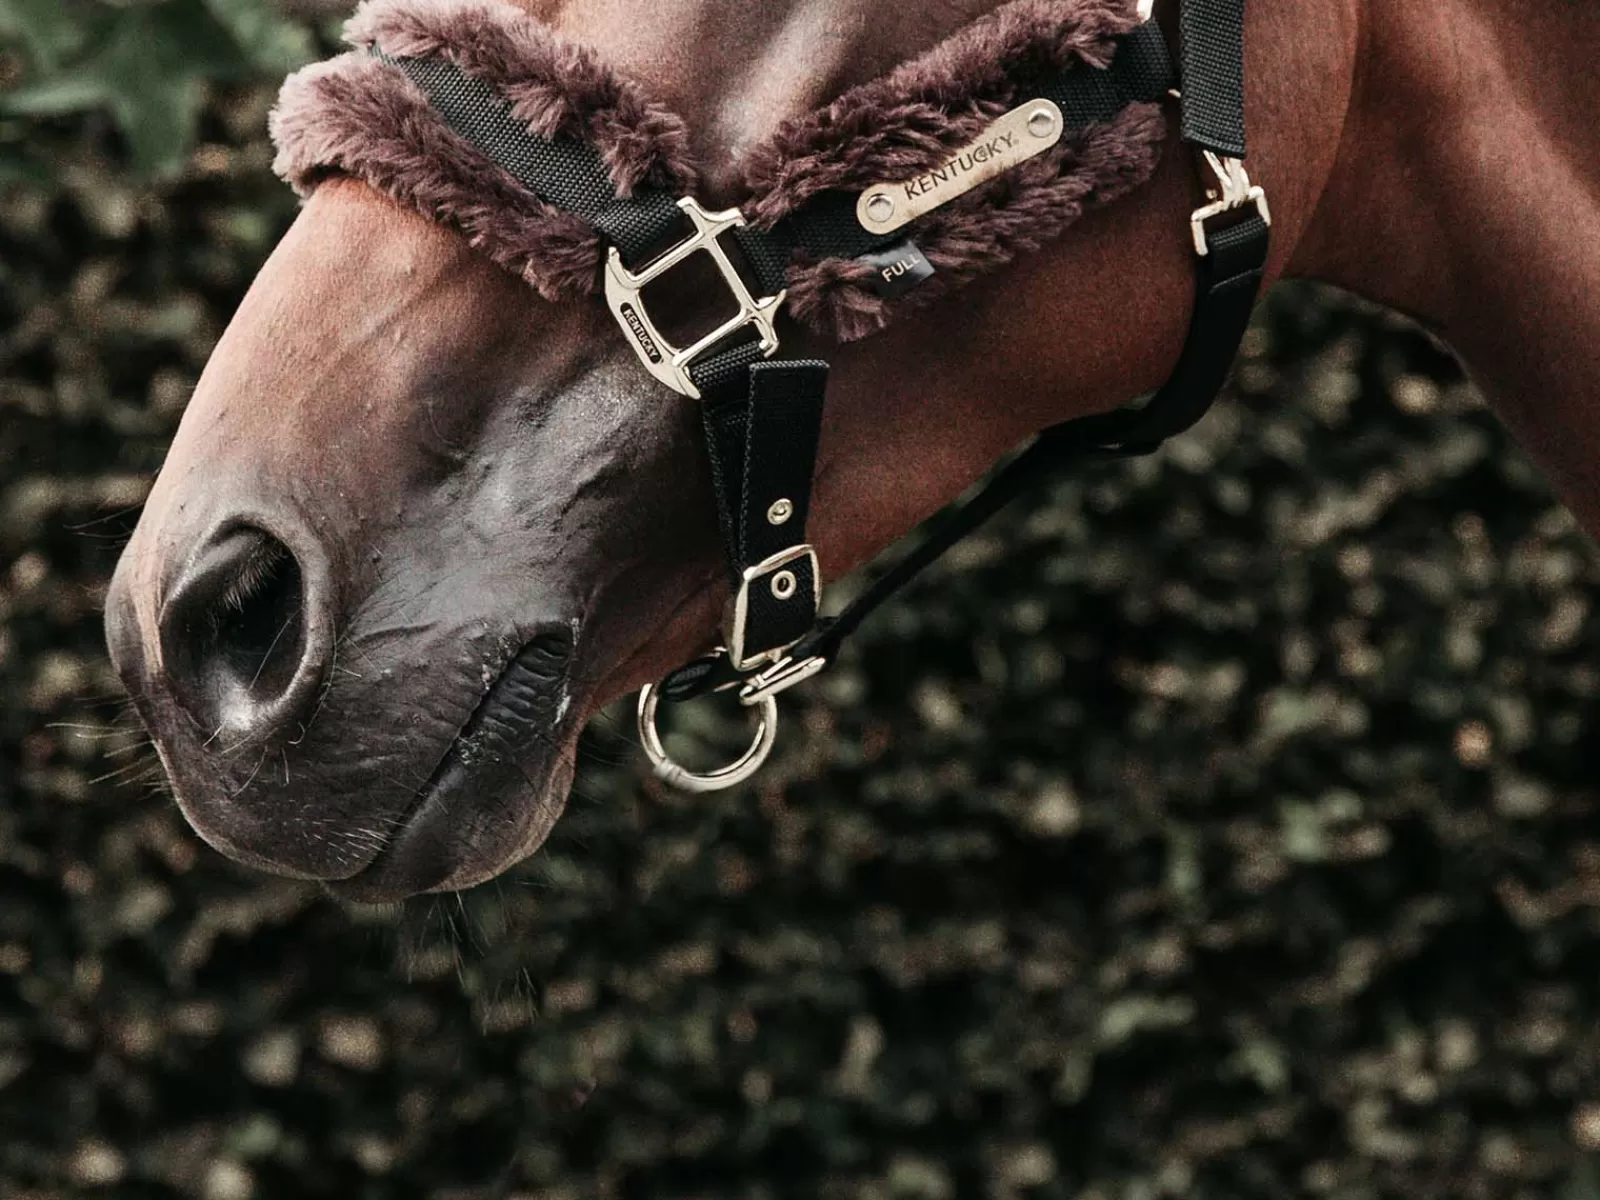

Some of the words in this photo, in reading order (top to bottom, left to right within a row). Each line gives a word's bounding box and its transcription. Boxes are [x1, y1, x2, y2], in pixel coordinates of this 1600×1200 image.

[904, 131, 1014, 200] KENTUCKY
[881, 254, 920, 282] FULL
[623, 308, 659, 358] KENTUCKY
